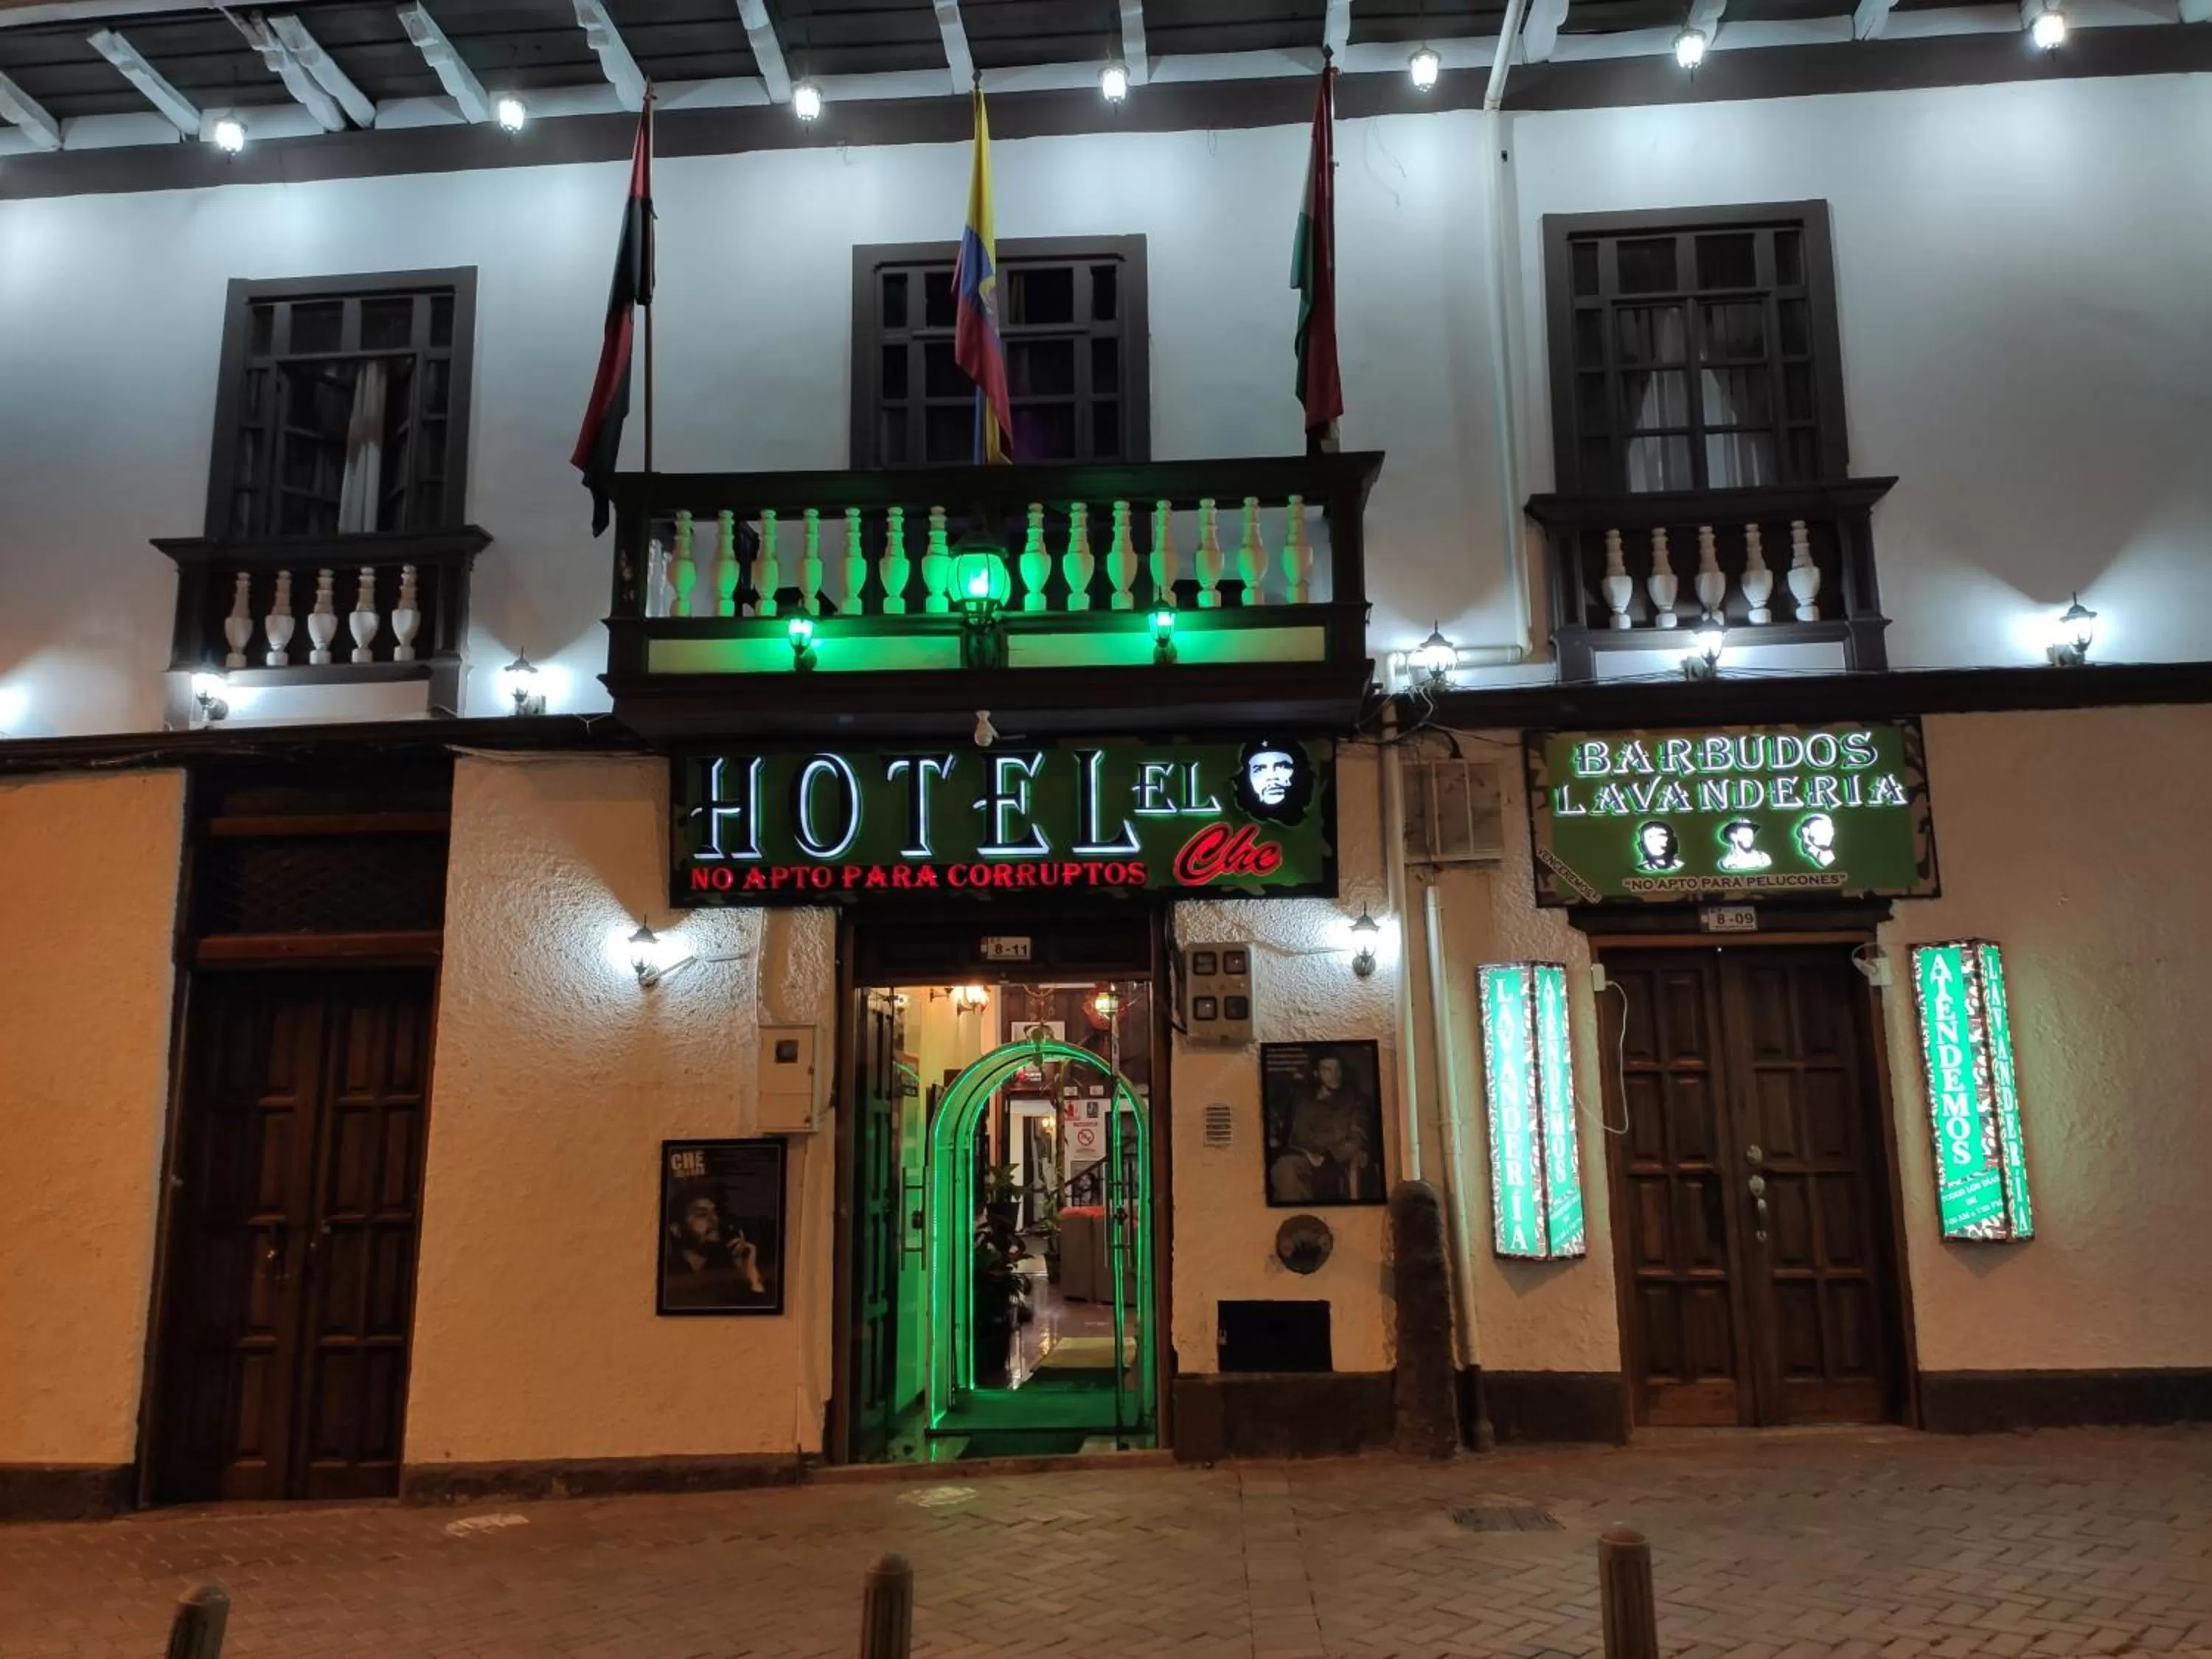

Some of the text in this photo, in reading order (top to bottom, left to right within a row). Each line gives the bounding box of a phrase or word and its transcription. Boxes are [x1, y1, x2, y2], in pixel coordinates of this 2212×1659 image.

[1576, 731, 1879, 776] BARBUDOS
[689, 748, 1222, 860] HOTEL EL
[1555, 773, 1908, 815] LAVANDERIA
[1173, 823, 1284, 886] Che
[690, 861, 1149, 891] NO APTO PARA CORRUPTOS
[1656, 877, 1699, 890] APTO
[1701, 875, 1744, 888] PARA
[1717, 913, 1754, 925] 8-09
[994, 943, 1027, 956] 8-11
[1929, 953, 1972, 1166] ATENDEMOS
